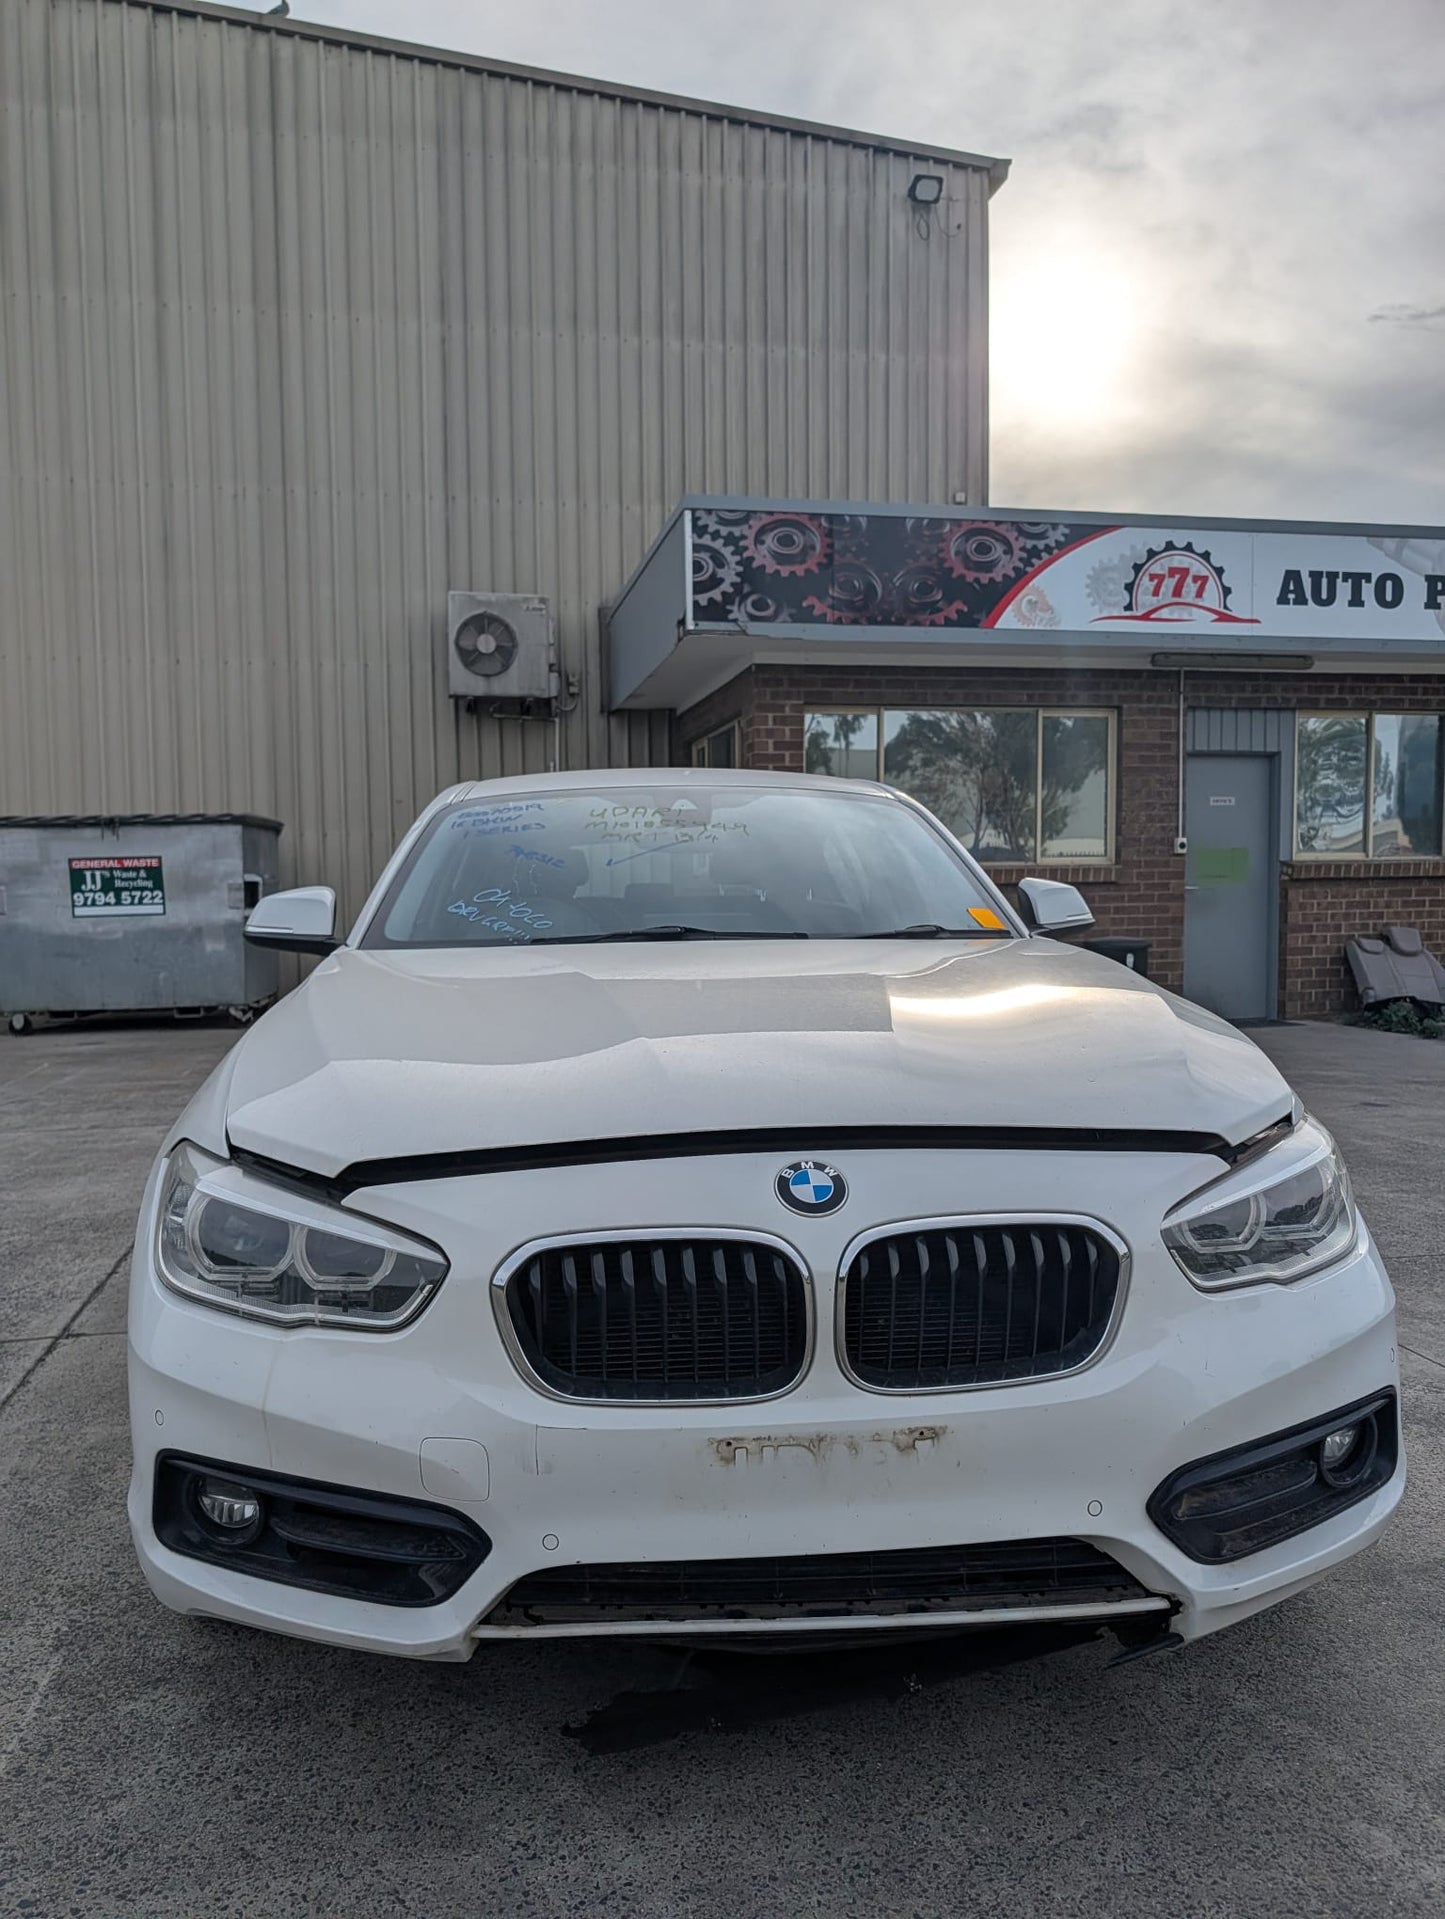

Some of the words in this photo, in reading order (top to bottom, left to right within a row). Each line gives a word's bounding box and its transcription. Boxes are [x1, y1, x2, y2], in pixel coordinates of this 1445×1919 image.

[1148, 567, 1209, 599] 777
[1276, 569, 1404, 609] AUTO
[71, 859, 120, 869] GENERAL
[122, 858, 159, 867] WASTE
[113, 870, 137, 878] Waste
[139, 869, 147, 878] &
[114, 879, 153, 889] Recycling
[73, 891, 116, 906] 9794
[121, 890, 163, 905] 5722
[781, 1161, 838, 1178] BMW
